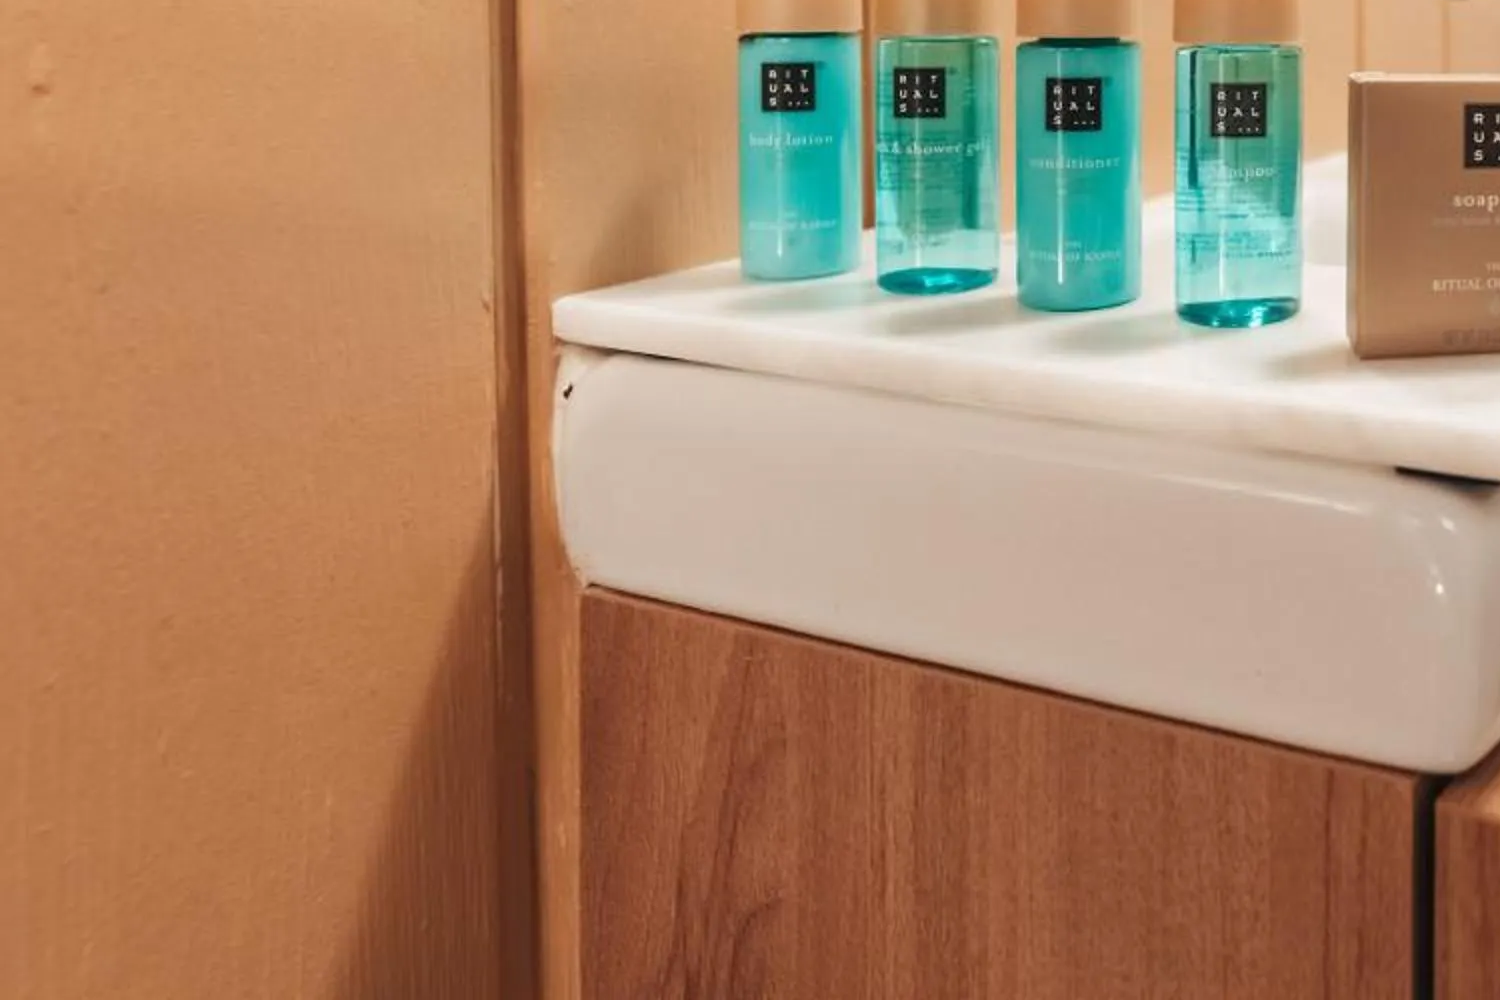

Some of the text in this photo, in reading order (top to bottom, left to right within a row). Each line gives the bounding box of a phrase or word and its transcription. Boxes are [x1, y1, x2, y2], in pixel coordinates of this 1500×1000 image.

[786, 132, 833, 146] lotion
[905, 140, 962, 155] shower
[1453, 193, 1499, 212] soap
[1432, 278, 1482, 291] RITUAL
